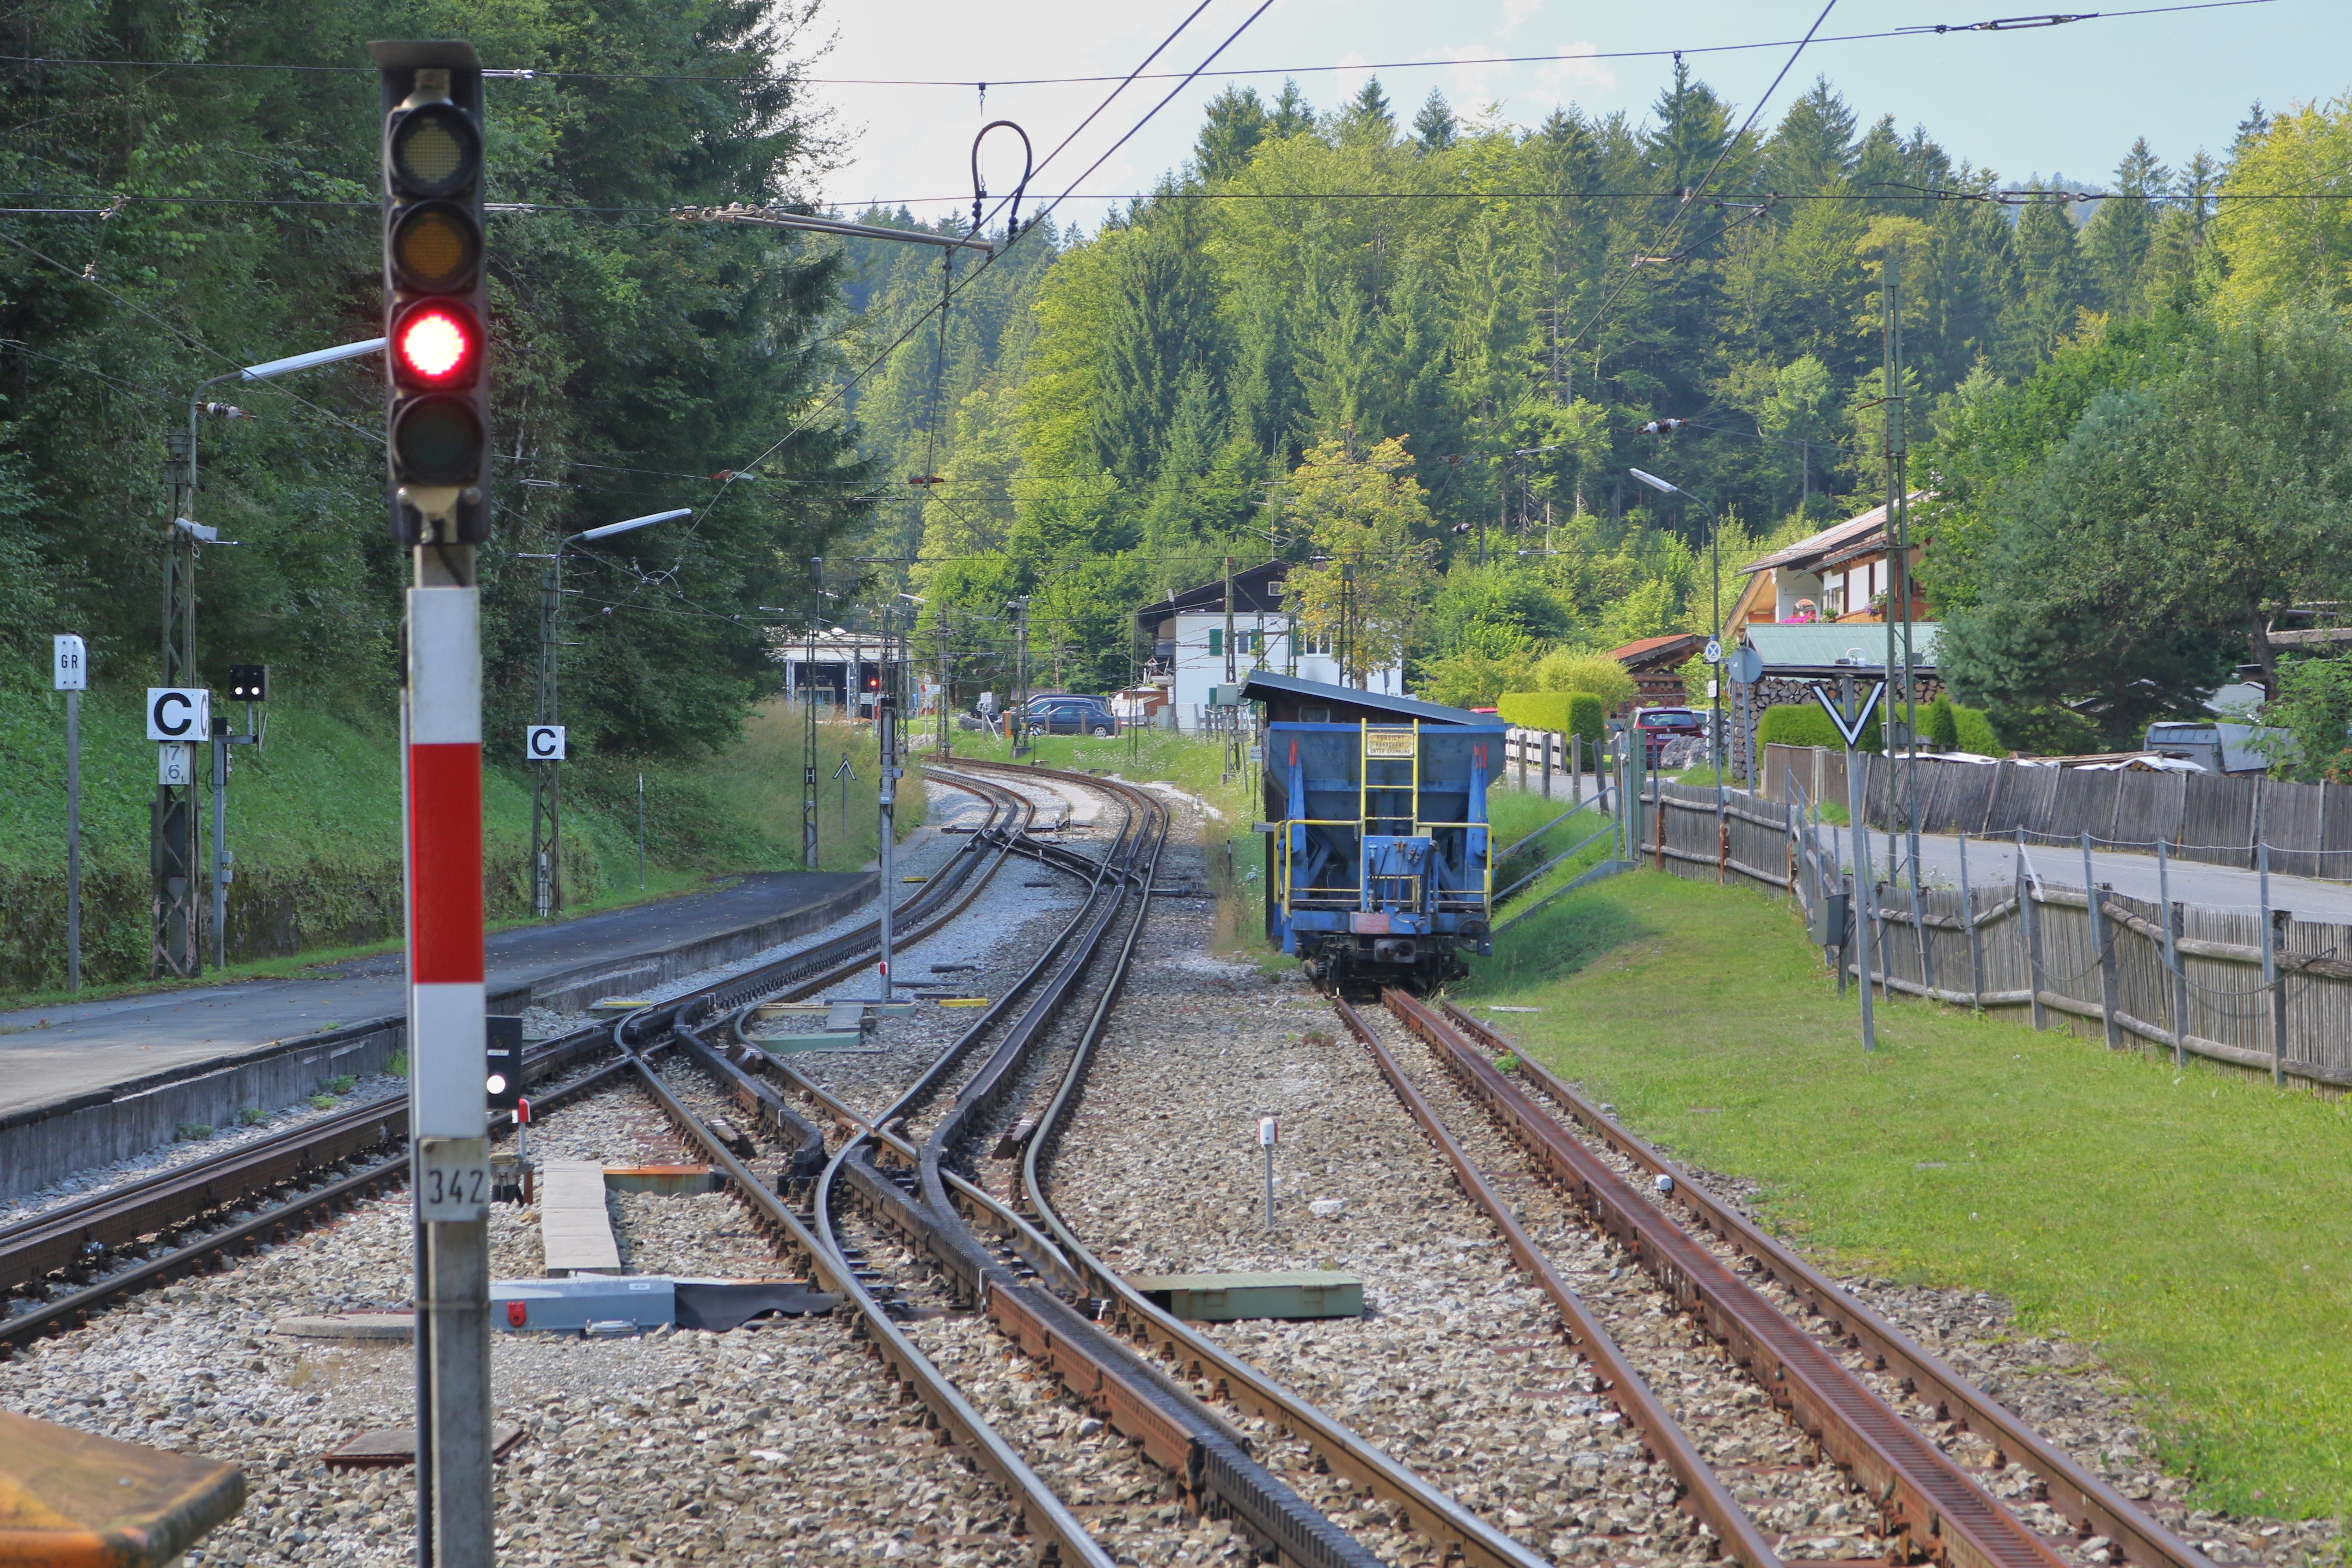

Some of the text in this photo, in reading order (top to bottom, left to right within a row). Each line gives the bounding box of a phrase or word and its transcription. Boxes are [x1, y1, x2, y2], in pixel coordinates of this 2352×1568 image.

[154, 692, 192, 736] C
[532, 729, 556, 756] C
[806, 769, 815, 783] H
[429, 1170, 484, 1204] 342
